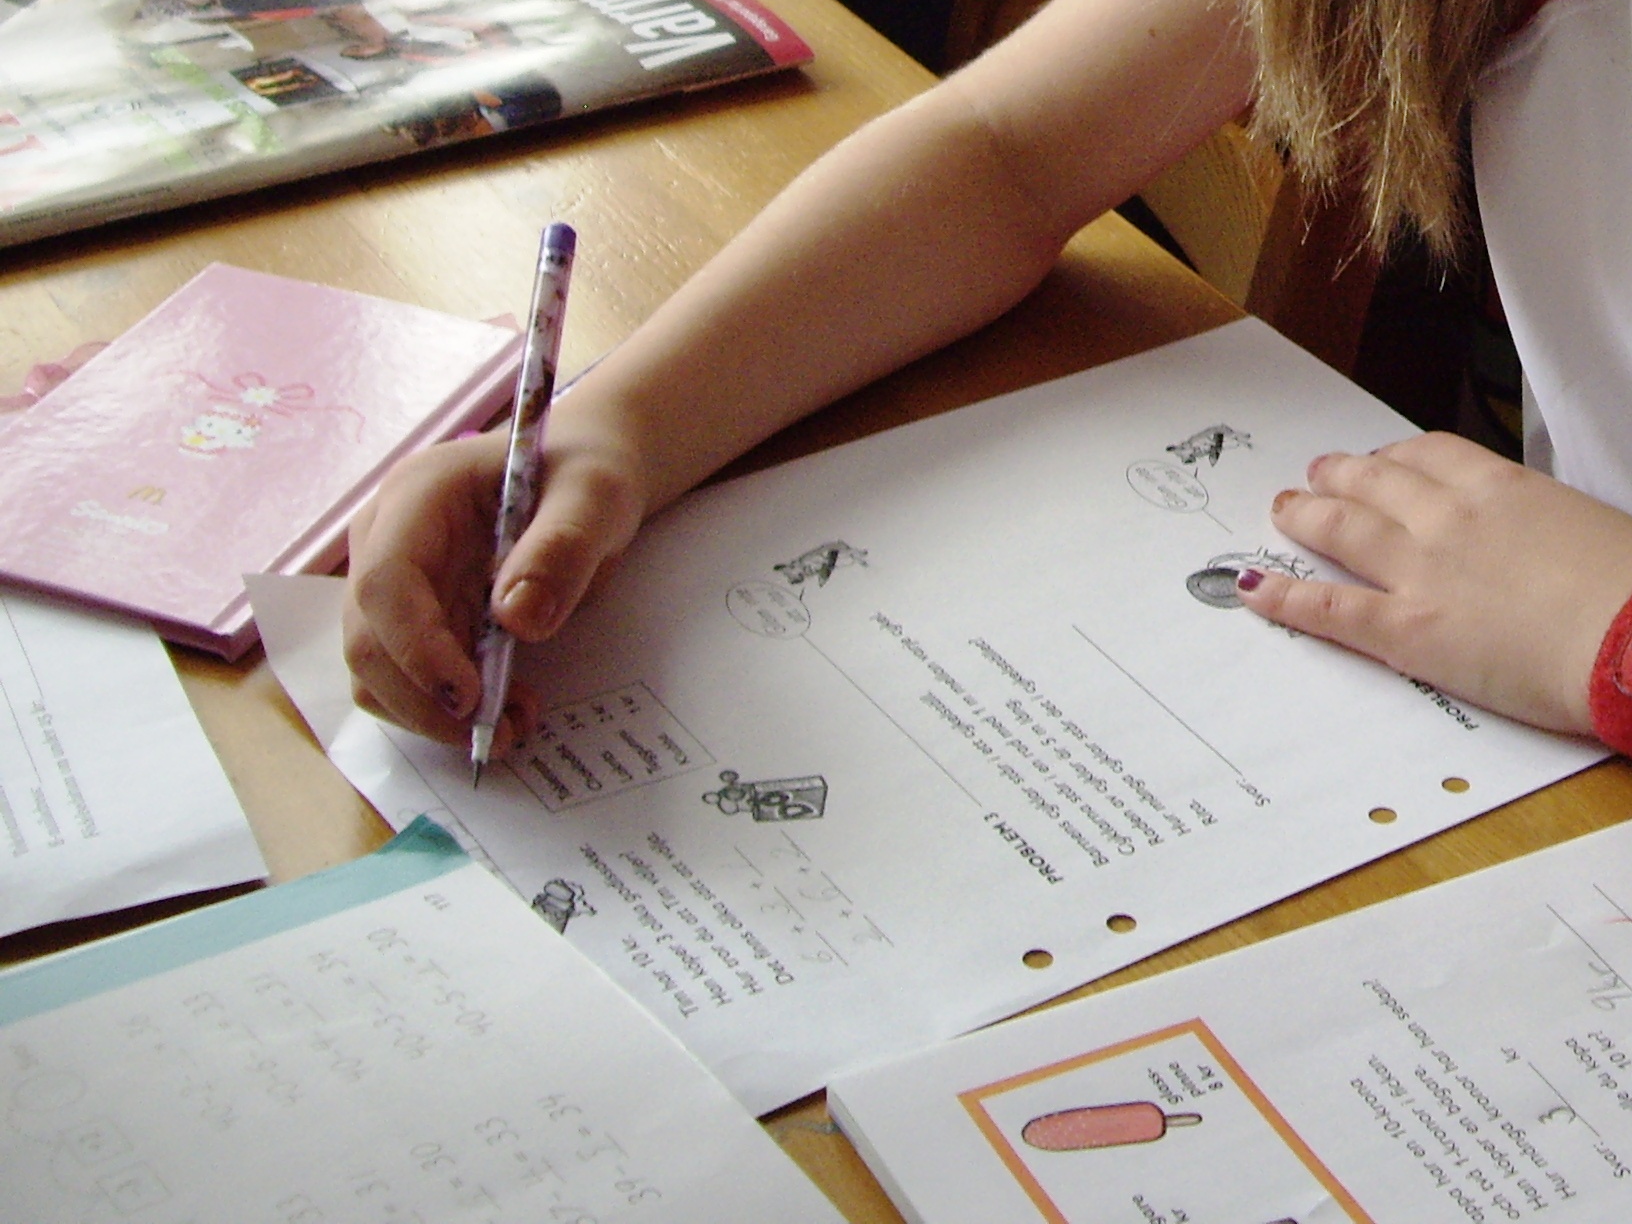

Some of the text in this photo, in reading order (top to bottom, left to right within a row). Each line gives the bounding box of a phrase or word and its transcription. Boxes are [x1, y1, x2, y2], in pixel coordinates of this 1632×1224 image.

[972, 708, 985, 716] 1
[981, 716, 1012, 738] med
[1031, 724, 1046, 736] m
[972, 739, 993, 755] ett
[1006, 739, 1033, 758] rad
[1041, 738, 1056, 746] 5
[997, 764, 1025, 785] står
[1032, 759, 1049, 773] en
[1069, 762, 1108, 793] cyklar
[1021, 787, 1060, 819] cyklar
[1054, 783, 1082, 803] står
[1106, 795, 1125, 808] av
[1237, 779, 1271, 807] Svar:
[1080, 804, 1135, 855] Cyklarna
[1124, 810, 1164, 846] Raden
[1163, 814, 1191, 836] Hur
[984, 812, 1063, 884] PROBLEM 3
[1059, 821, 1109, 867] Barnens
[672, 861, 693, 878] att
[657, 887, 679, 910] Tim
[633, 905, 663, 931] olika
[677, 908, 698, 925] att
[713, 902, 743, 929] olika
[656, 934, 673, 944] 3
[695, 926, 714, 942] du
[741, 931, 771, 959] finns
[632, 953, 654, 968] 10
[669, 945, 706, 979] köper
[711, 946, 739, 969] tror
[652, 970, 677, 992] har
[735, 971, 763, 995] Hur
[767, 960, 795, 985] Det
[674, 991, 699, 1018] Tim
[704, 979, 732, 1007] Han
[1587, 1031, 1615, 1051] kr?
[1565, 1038, 1599, 1072] köpa
[1609, 1053, 1631, 1069] 10
[1148, 1068, 1183, 1103] glass-
[1169, 1062, 1206, 1097] pinne
[1198, 1066, 1223, 1090] 8 kr
[1362, 979, 1576, 1200] Hur många kronor har han sedan?
[1598, 1072, 1618, 1089] du
[1350, 1078, 1406, 1139] 10-krona
[1501, 1048, 1631, 1178] Svar: 3 kr
[1368, 1054, 1520, 1219] och två 1-kronor i fickan.
[1414, 1065, 1548, 1211] Han köper en bägare.
[1406, 1140, 1426, 1158] en
[1423, 1162, 1451, 1187] har
